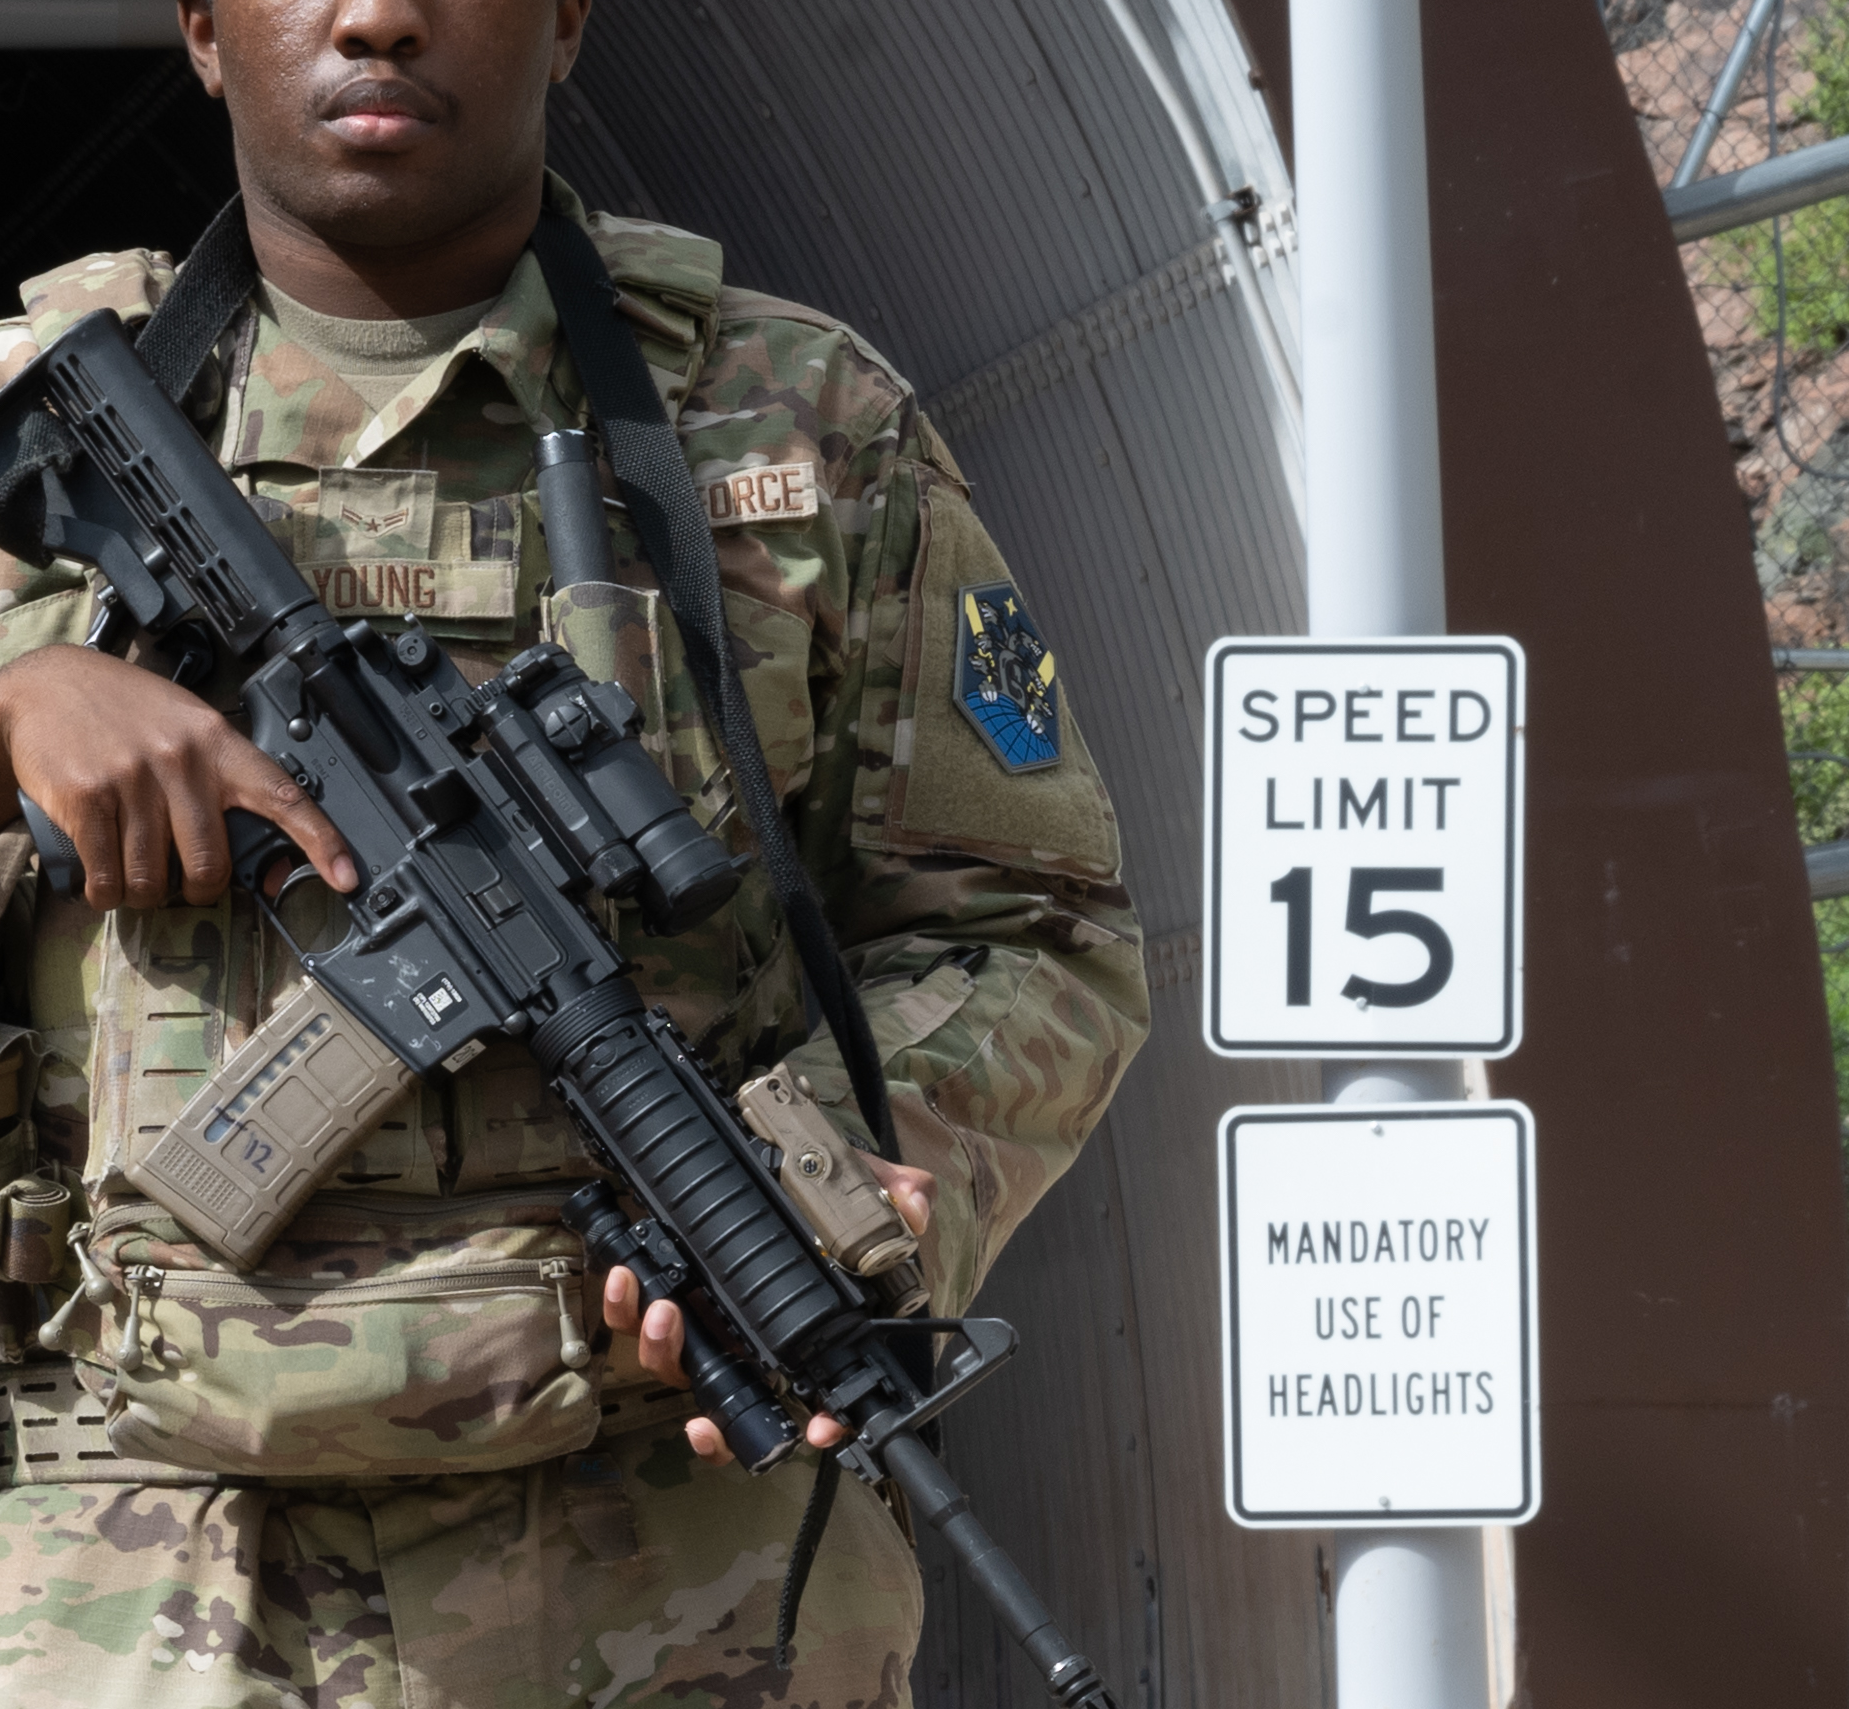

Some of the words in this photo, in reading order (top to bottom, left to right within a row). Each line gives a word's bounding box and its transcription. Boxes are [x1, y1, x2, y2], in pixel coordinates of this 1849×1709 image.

[702, 470, 803, 519] ORCE
[312, 564, 436, 609] YOUNG
[1238, 689, 1491, 743] SPEED
[1266, 777, 1461, 830] LIMIT
[1270, 867, 1454, 1008] 15
[1267, 1218, 1490, 1265] MANDATORY
[1315, 1296, 1382, 1340] USE
[1401, 1295, 1446, 1339] OF
[1269, 1371, 1494, 1417] HEADLIGHTS
